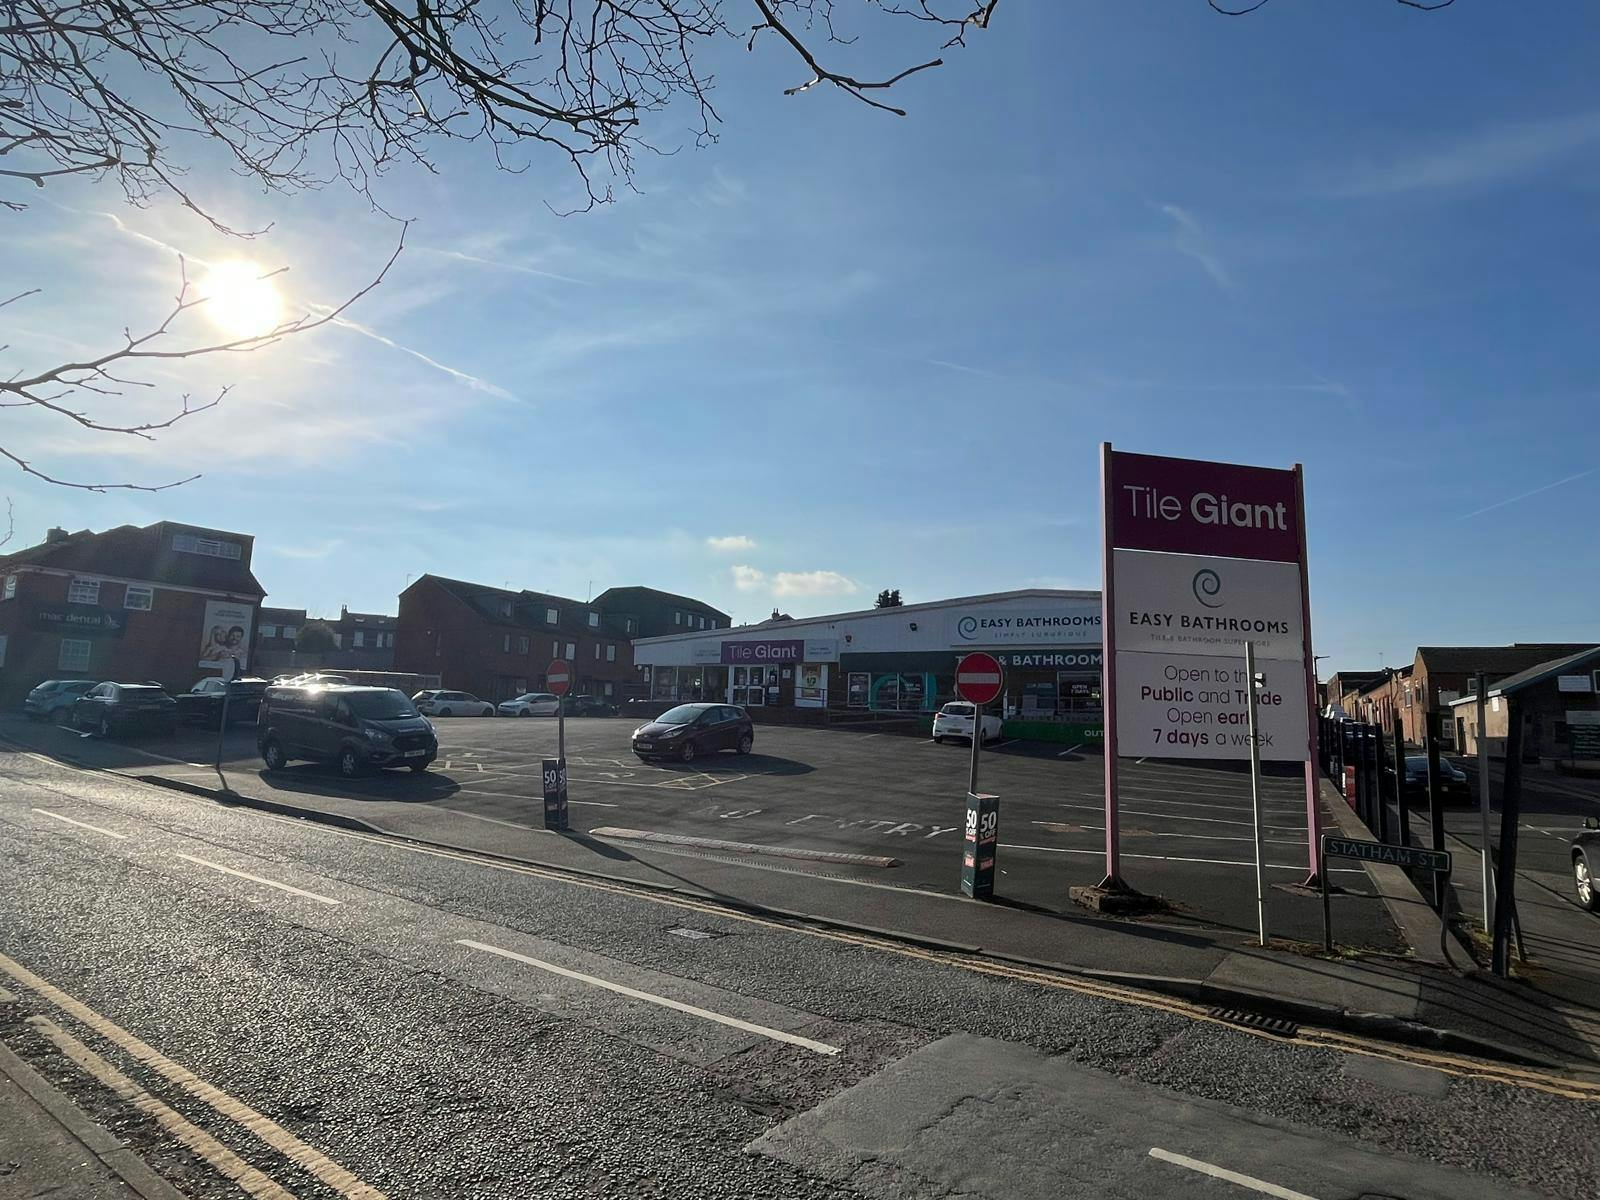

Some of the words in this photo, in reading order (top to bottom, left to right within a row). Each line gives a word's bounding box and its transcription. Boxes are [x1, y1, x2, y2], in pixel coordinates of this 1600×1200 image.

[1123, 484, 1182, 521] Tile
[1190, 492, 1287, 531] Giant
[66, 614, 101, 625] dental
[981, 618, 1012, 628] EASY
[1016, 616, 1101, 627] BATHROOMS
[1130, 611, 1173, 627] EASY
[1181, 615, 1289, 634] BATHROOMS
[1178, 635, 1221, 645] BATHROOM
[728, 645, 752, 659] Tile
[755, 645, 797, 659] Giant
[1164, 665, 1210, 683] Open
[1214, 668, 1229, 683] to
[1141, 686, 1194, 702] Public
[1199, 690, 1230, 704] and
[1167, 707, 1212, 726] Open
[1218, 708, 1250, 725] earl
[1153, 728, 1162, 743] 7
[1167, 729, 1209, 747] days
[1215, 733, 1227, 745] a
[544, 769, 557, 784] 50
[966, 808, 977, 829] 50
[980, 811, 997, 833] 50
[1331, 841, 1411, 863] STATHAM
[1420, 853, 1439, 867] ST
